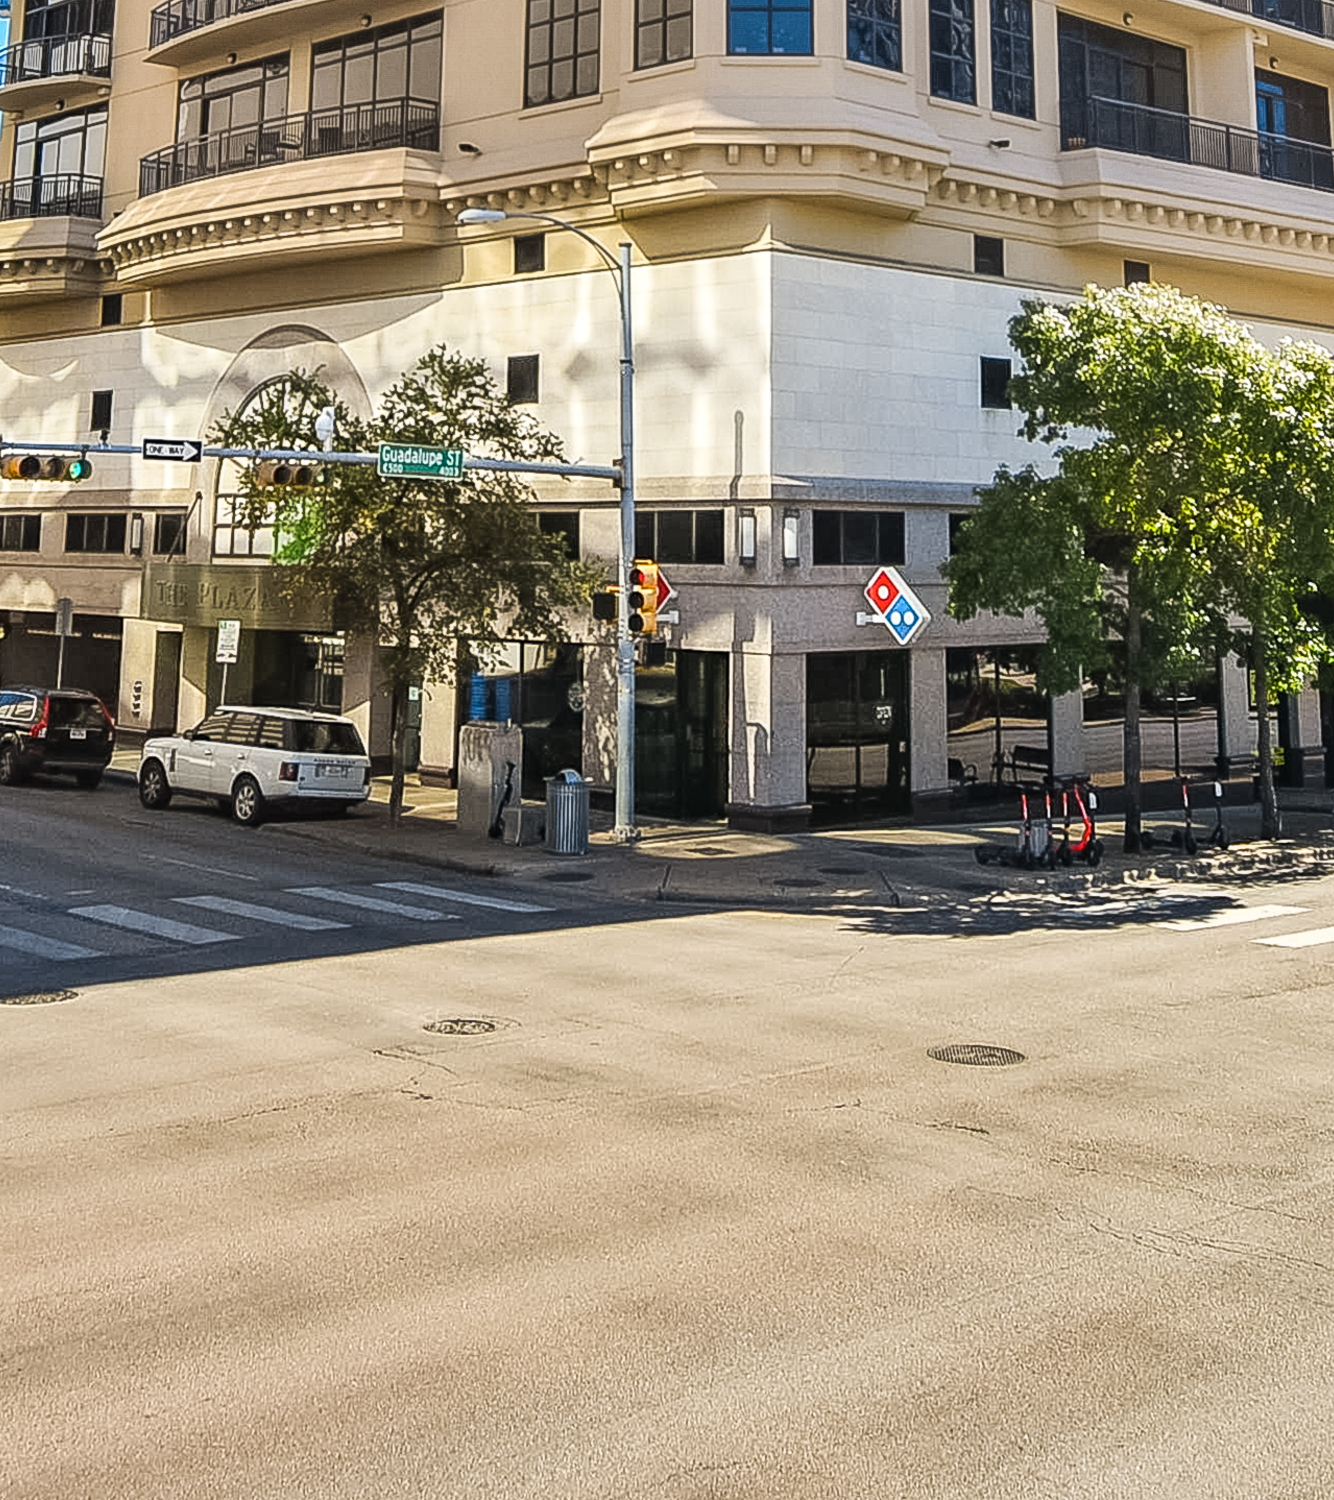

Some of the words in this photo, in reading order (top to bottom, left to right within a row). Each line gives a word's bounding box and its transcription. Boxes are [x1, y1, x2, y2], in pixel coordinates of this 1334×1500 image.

[169, 447, 184, 455] WAY
[382, 446, 443, 467] Guadalupe
[447, 450, 461, 466] ST
[155, 580, 188, 608] THE
